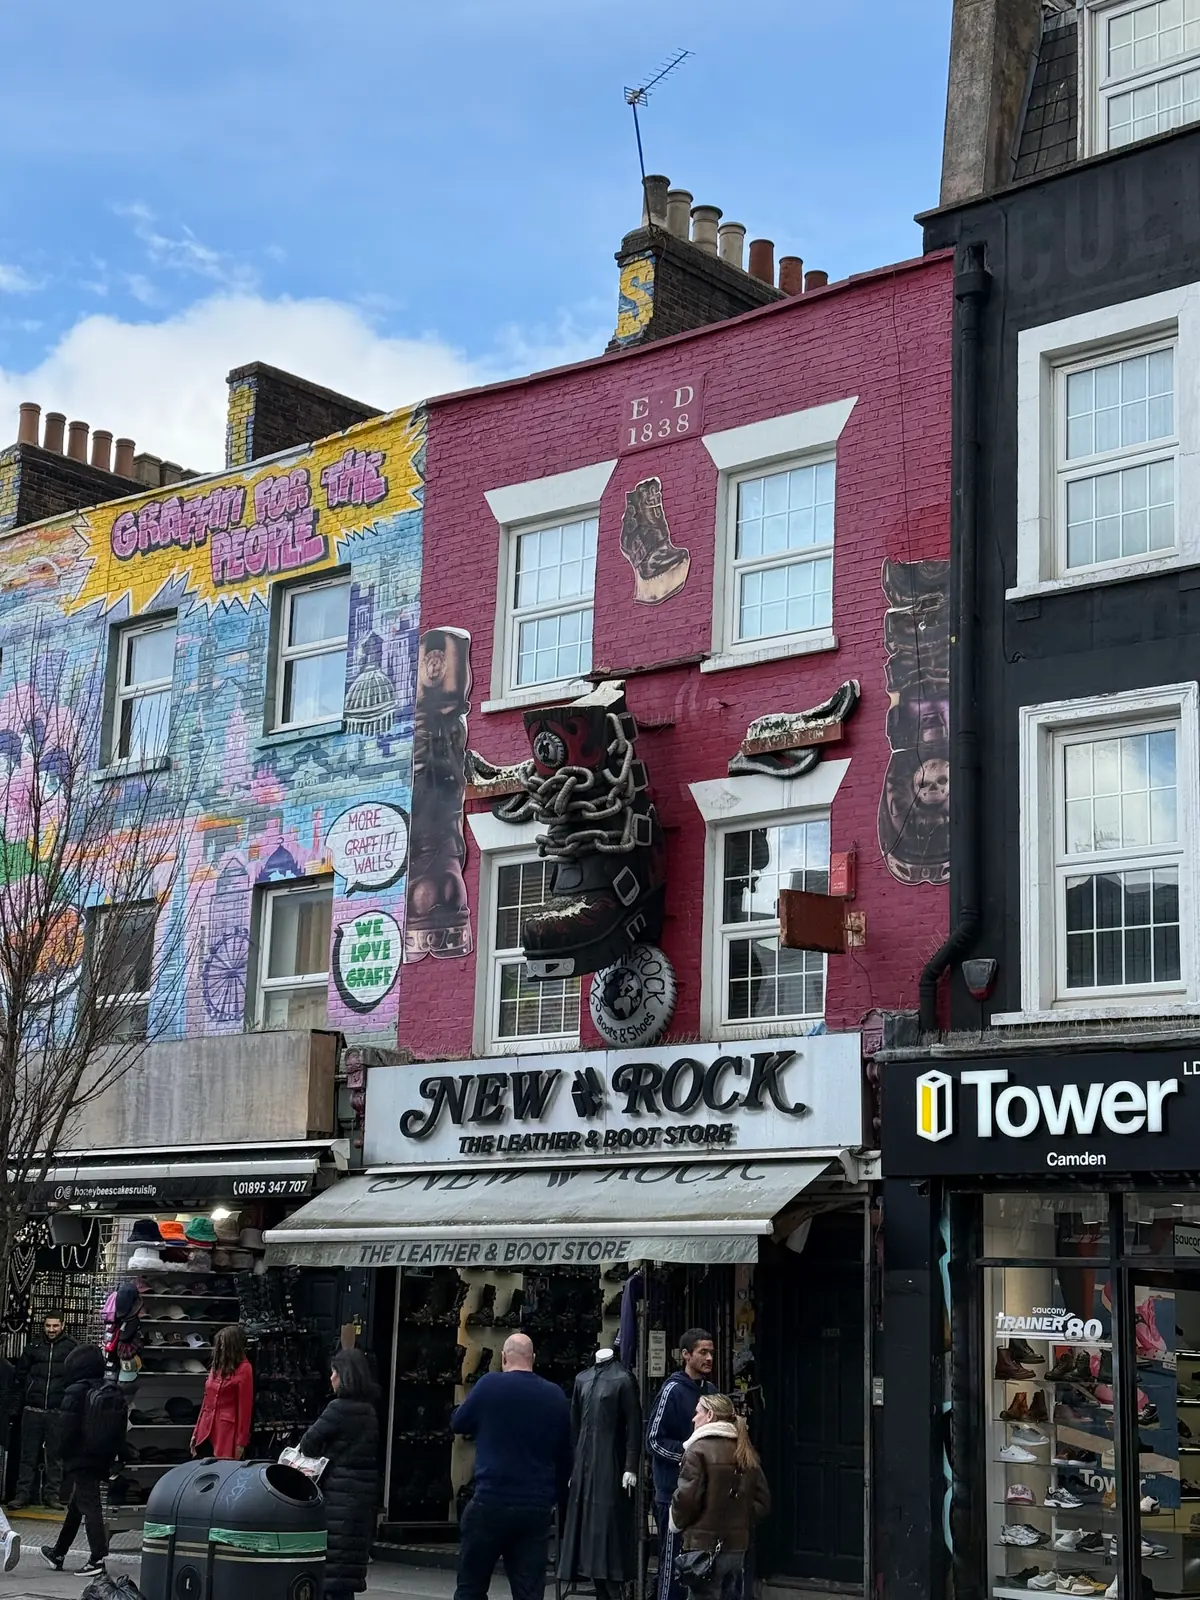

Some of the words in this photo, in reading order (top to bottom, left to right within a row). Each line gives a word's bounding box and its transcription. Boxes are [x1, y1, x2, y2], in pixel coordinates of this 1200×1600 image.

[628, 396, 649, 421] E
[672, 385, 694, 409] D
[627, 413, 689, 446] 1838
[111, 485, 247, 558] GRAFFITI
[254, 468, 310, 522] FOR
[321, 447, 387, 507] THE
[210, 508, 324, 582] PEOPLE
[349, 808, 382, 830] MORE
[344, 832, 398, 856] GRAFFITI
[354, 918, 384, 937] WE
[351, 939, 391, 963] LOVE
[346, 966, 393, 988] GRAFF
[631, 946, 665, 1010] ROCK
[400, 1068, 562, 1139] NEW
[611, 1049, 807, 1115] ROCK
[960, 1068, 1179, 1138] Tower
[458, 1133, 494, 1154] THE
[496, 1129, 582, 1153] LEATHER
[584, 1128, 599, 1148] &
[603, 1126, 662, 1148] BOOT
[663, 1122, 734, 1145] STORE
[1046, 1151, 1107, 1167] Camden
[238, 1181, 266, 1195] 01895
[268, 1180, 287, 1194] 347
[288, 1180, 308, 1193] 707
[360, 1244, 396, 1264] THE
[398, 1242, 482, 1263] LEATHER
[484, 1242, 499, 1261] &
[503, 1241, 560, 1262] BOOT
[561, 1240, 632, 1262] STORE
[1032, 1306, 1067, 1317] saucony
[995, 1315, 1064, 1332] TRAINER
[1066, 1318, 1103, 1341] 80
